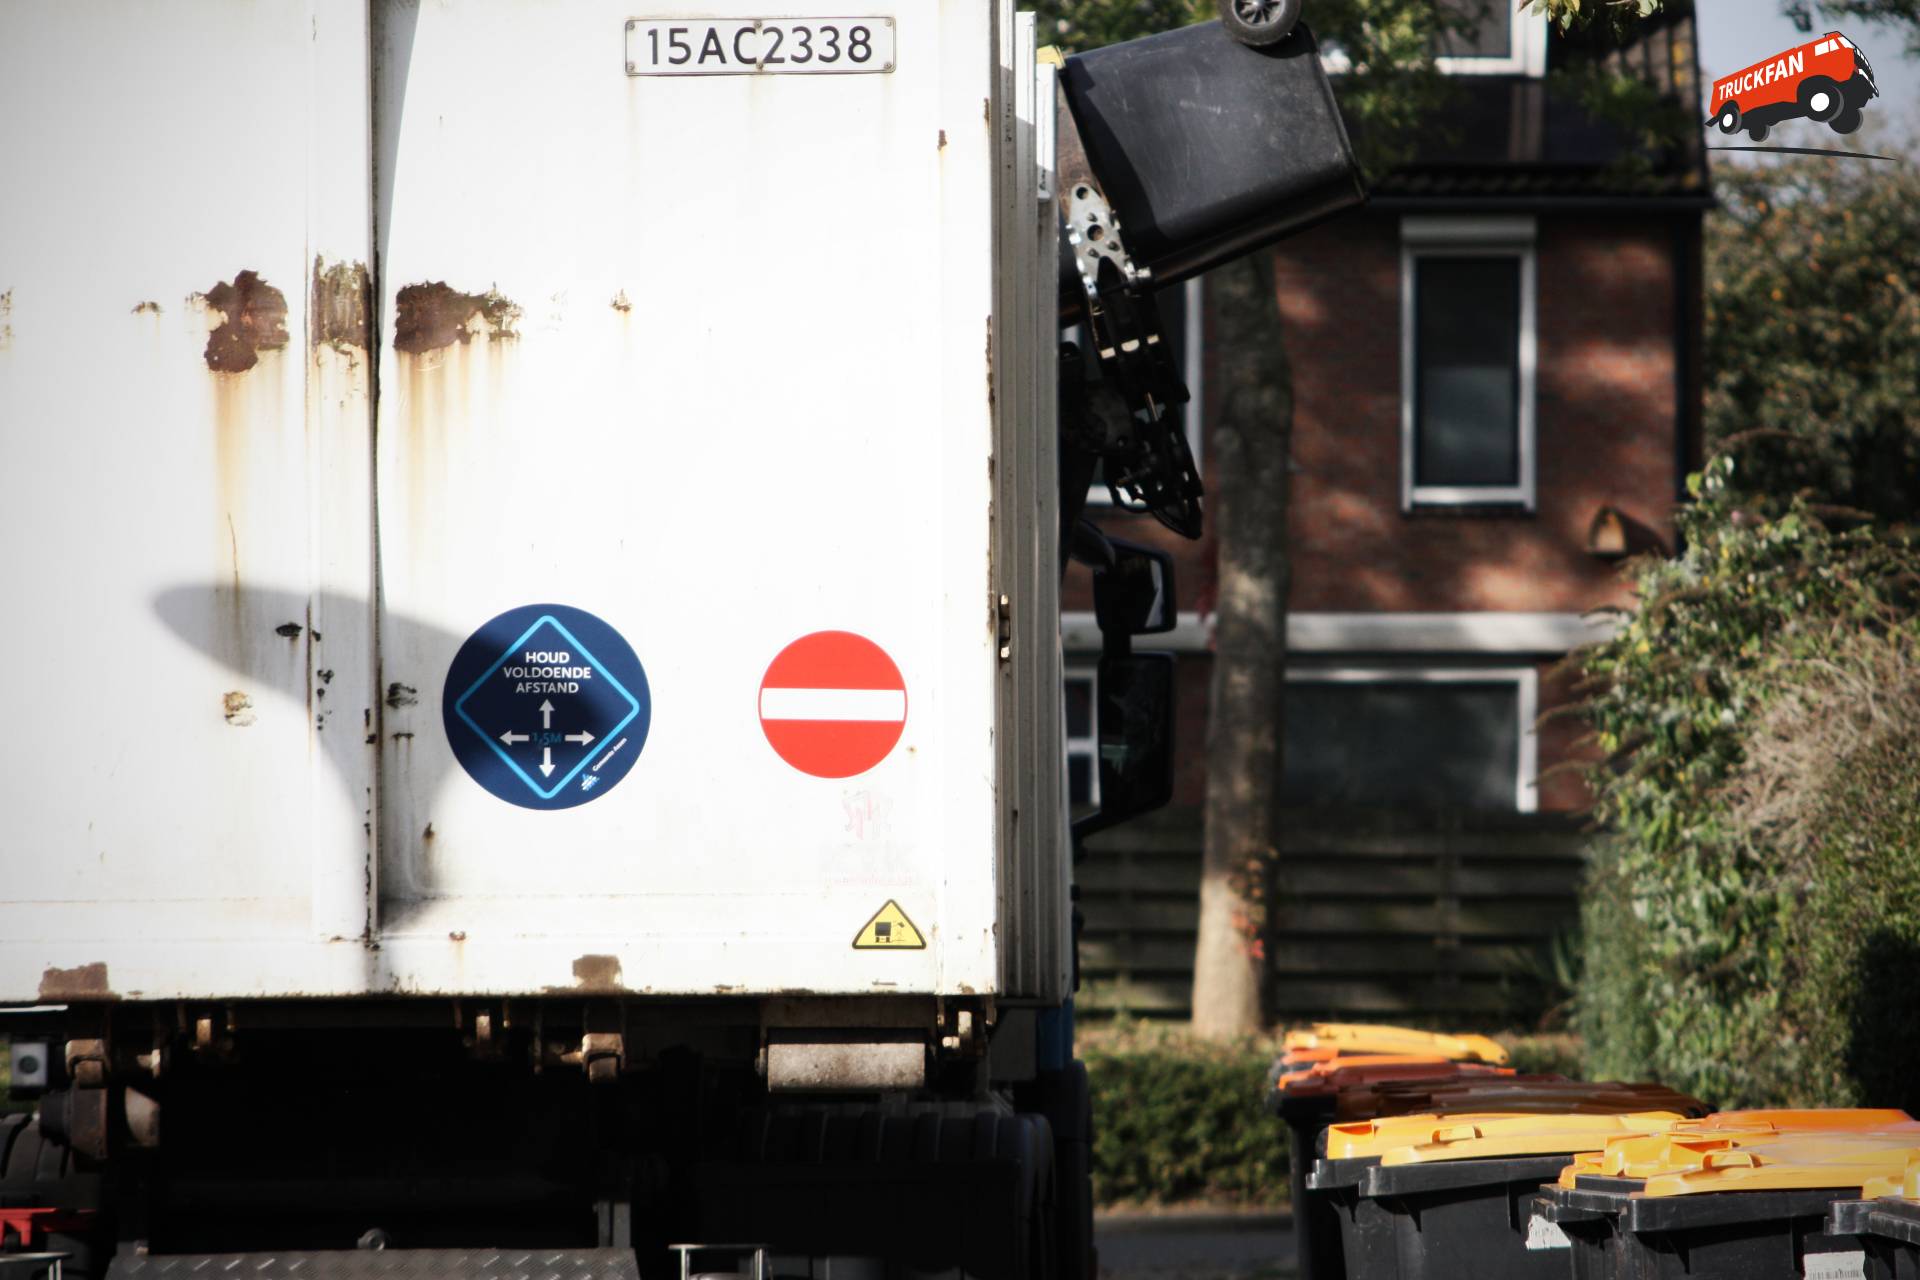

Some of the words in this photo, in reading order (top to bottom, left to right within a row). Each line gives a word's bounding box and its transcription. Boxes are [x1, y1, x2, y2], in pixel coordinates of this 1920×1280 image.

[647, 25, 872, 65] 15AC2338
[525, 652, 570, 663] HOUD
[504, 667, 591, 678] VOLDOENDE
[515, 682, 579, 693] AFSTAND
